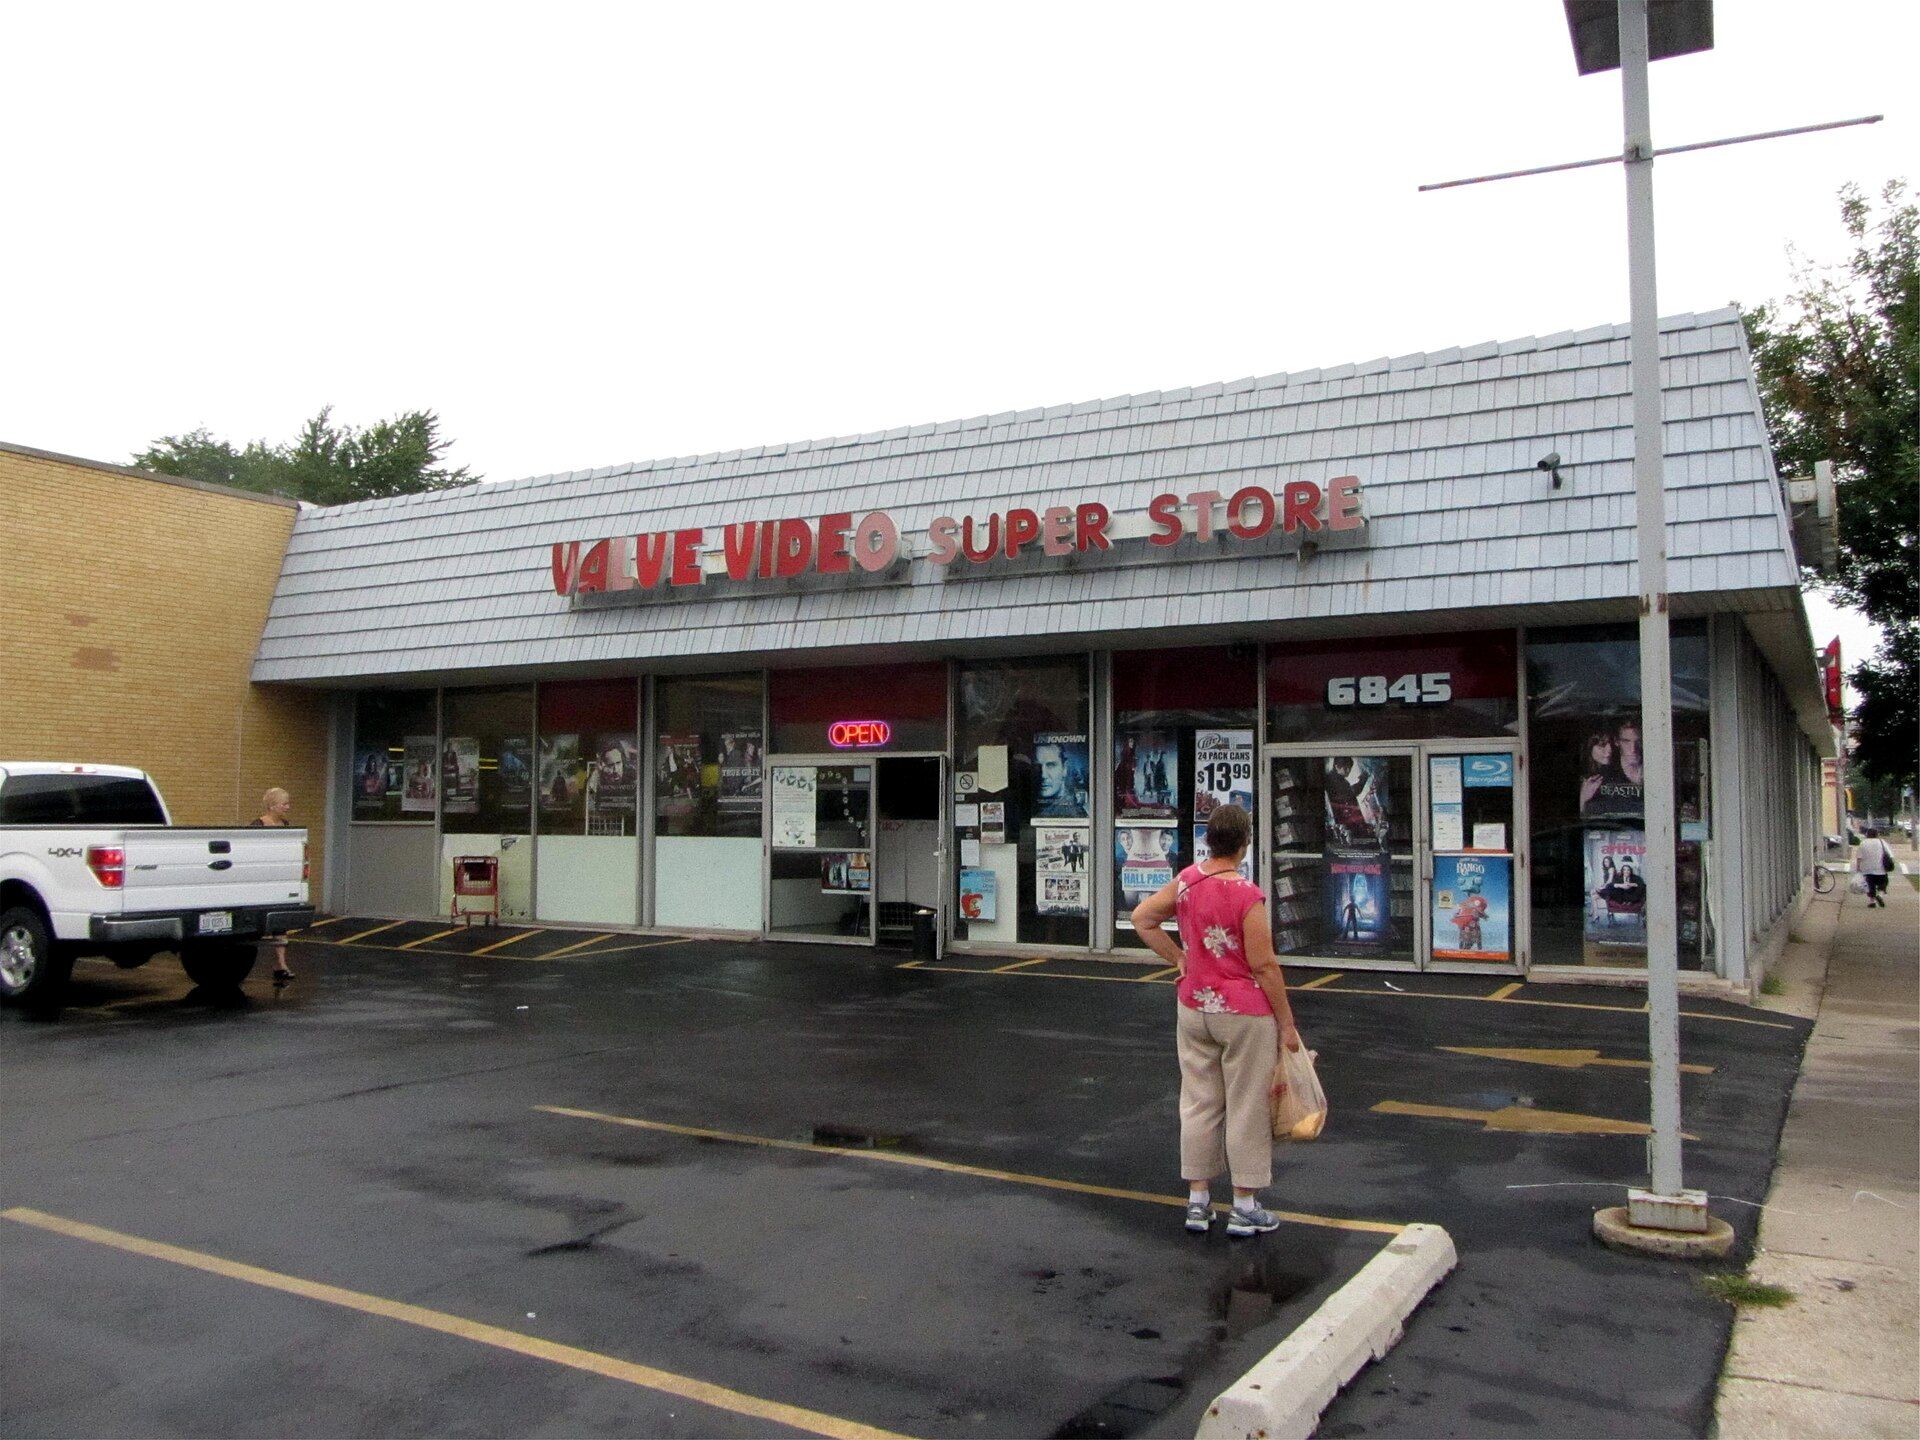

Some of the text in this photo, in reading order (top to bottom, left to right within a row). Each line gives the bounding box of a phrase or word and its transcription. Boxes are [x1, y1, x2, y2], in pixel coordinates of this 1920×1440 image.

[724, 511, 902, 581] VIDEO
[927, 502, 1111, 565] SUPER
[1148, 475, 1364, 546] STORE
[1328, 672, 1452, 706] 6845
[832, 723, 884, 744] OPEN
[1033, 734, 1087, 744] UNKNOWN
[1197, 752, 1250, 761] 24 PACK CANS
[1600, 784, 1643, 798] BEASTLY
[1601, 843, 1647, 855] arthu
[1456, 862, 1485, 876] RANGO
[1123, 872, 1172, 885] HALL PASS
